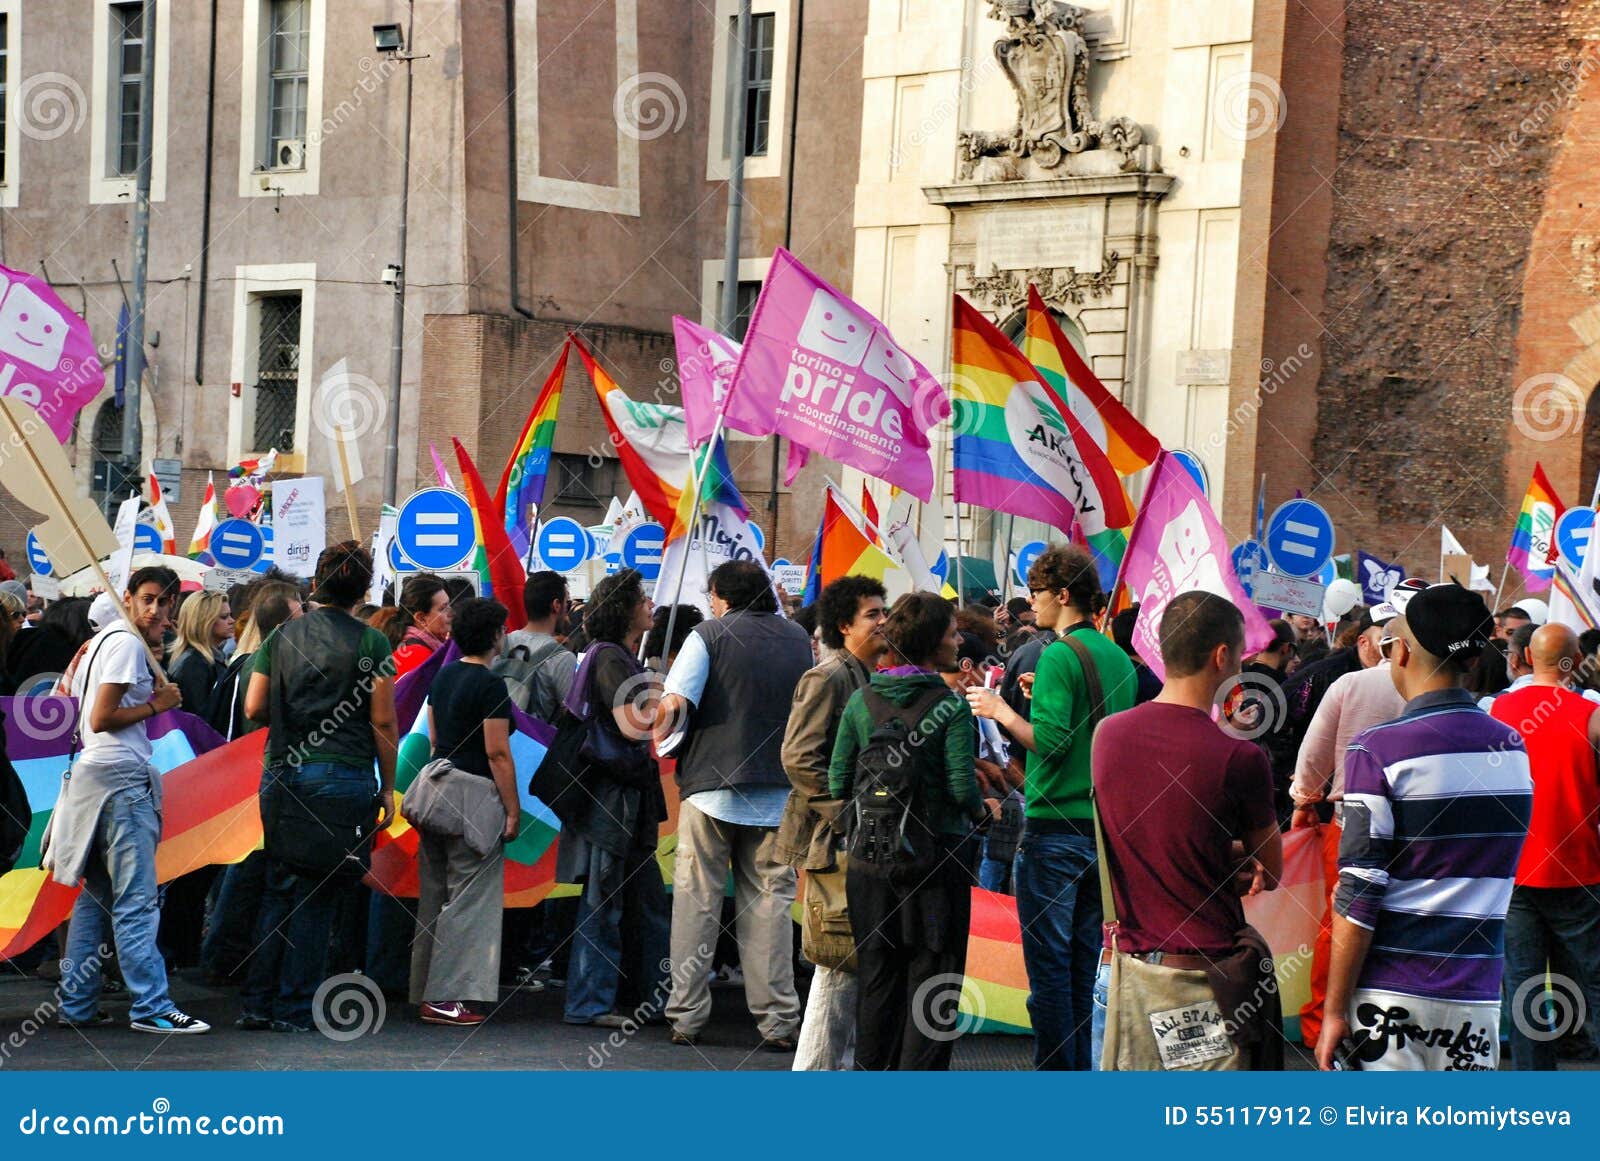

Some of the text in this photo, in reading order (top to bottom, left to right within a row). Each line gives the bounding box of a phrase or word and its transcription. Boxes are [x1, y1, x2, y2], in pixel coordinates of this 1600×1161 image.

[791, 348, 842, 378] torino
[780, 362, 903, 440] pride
[798, 402, 901, 454] coordinamento
[1447, 639, 1470, 652] NEW
[1155, 1009, 1221, 1038] ALL STAR
[1352, 1003, 1491, 1062] Frankie
